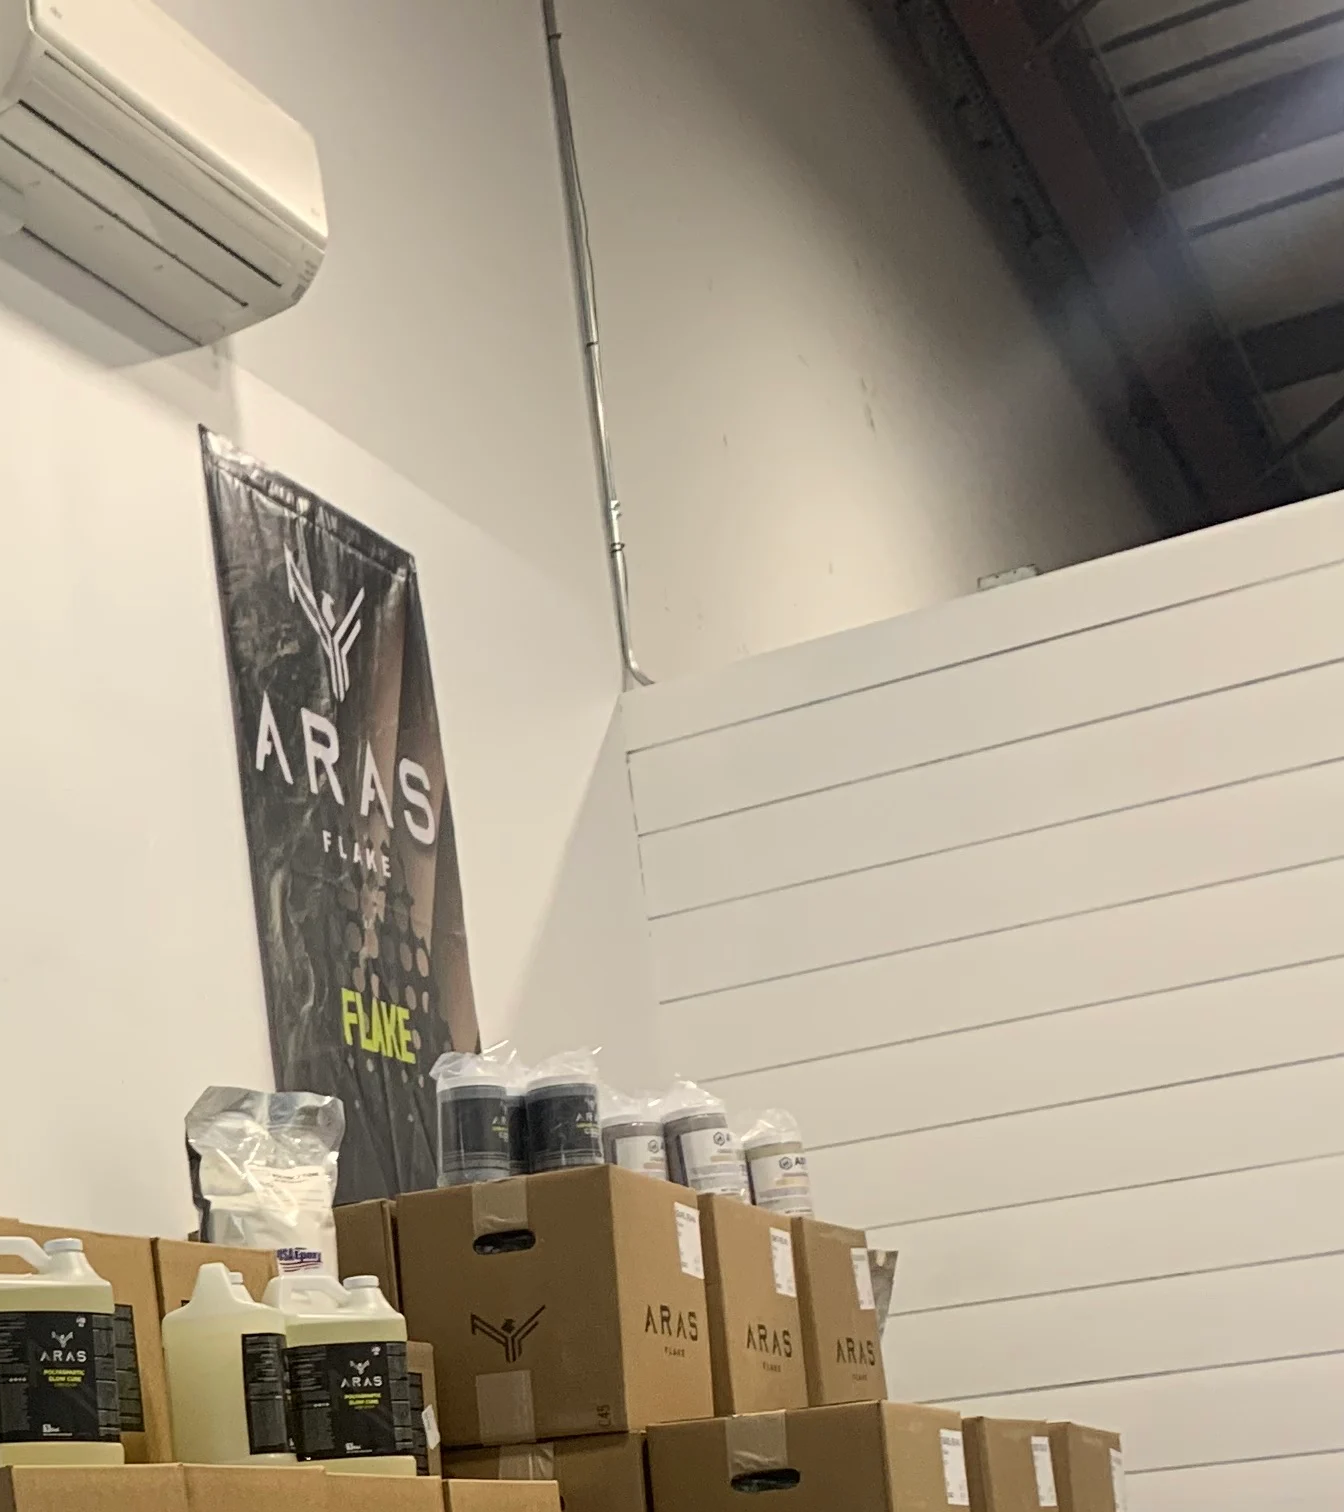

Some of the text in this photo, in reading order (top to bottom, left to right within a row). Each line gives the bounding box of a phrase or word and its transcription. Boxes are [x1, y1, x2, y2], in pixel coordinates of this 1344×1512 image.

[256, 691, 436, 846] ARAS
[323, 829, 391, 878] FLAKE
[342, 987, 416, 1064] FLAKE
[645, 1305, 698, 1341] ARAS
[746, 1321, 793, 1358] ARAS
[40, 1350, 87, 1362] ARAS
[836, 1337, 875, 1366] ARAS
[341, 1376, 383, 1388] ARAS
